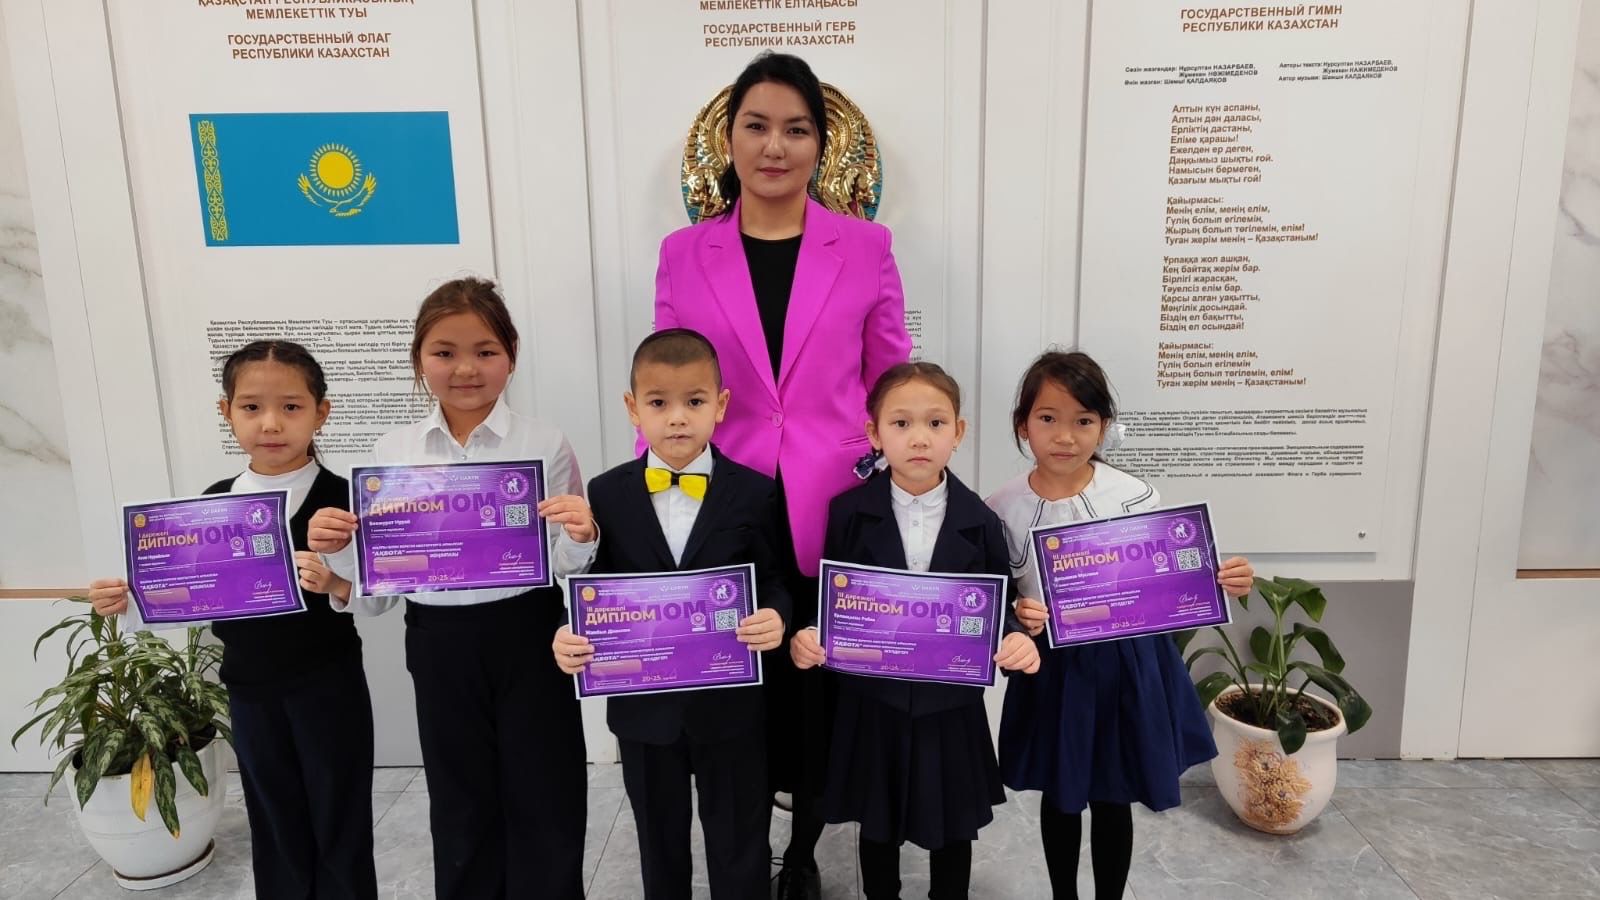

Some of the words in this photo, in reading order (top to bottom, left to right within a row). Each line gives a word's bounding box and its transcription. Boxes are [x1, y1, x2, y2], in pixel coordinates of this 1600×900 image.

[700, 0, 782, 10] МЕМЛЕКЕТТІК
[246, 8, 335, 19] МЕМЛЕКЕТТІК
[340, 8, 367, 18] ТУЫ
[1181, 5, 1305, 20] ГОСУДАРСТВЕННЫЙ
[1308, 5, 1342, 15] ГИМН
[704, 21, 822, 35] ГОСУДАРСТВЕННЫЙ
[826, 21, 856, 31] ГЕРБ
[1183, 21, 1264, 32] РЕСПУБЛИКИ
[1268, 19, 1338, 30] КАЗАХСТАН
[228, 32, 354, 46] ГОСУДАРСТВЕННЫЙ
[358, 33, 391, 43] ФЛАГ
[705, 37, 783, 47] РЕСПУБЛИКИ
[786, 35, 854, 45] КАЗАХСТАН
[232, 48, 314, 59] РЕСПУБЛИКИ
[318, 48, 390, 58] КАЗАХСТАН
[1205, 105, 1221, 114] күн
[1172, 115, 1203, 123] Алтын
[1204, 116, 1222, 124] дән
[1224, 115, 1262, 123] даласы,
[1171, 125, 1209, 135] Ерліктің
[1210, 125, 1252, 133] дастаны,
[1170, 135, 1197, 144] Еліме
[1200, 135, 1239, 144] қарашы!
[1170, 146, 1210, 154] Ежелден
[1212, 146, 1224, 155] ер
[1225, 146, 1253, 154] деген,
[1169, 156, 1218, 165] Даңқымыз
[1256, 154, 1273, 162] ғой.
[1168, 166, 1214, 174] Намысын
[1216, 165, 1261, 174] бермеген,
[1168, 176, 1207, 185] Қазағым
[1243, 174, 1262, 183] ғой!
[1167, 196, 1224, 205] Қайырмасы:
[1166, 204, 1193, 215] Менің
[1194, 205, 1217, 214] елім,
[1247, 205, 1270, 213] елім,
[1166, 216, 1190, 226] Гүлің
[1192, 216, 1222, 224] болып
[1224, 215, 1263, 223] егілемін,
[1165, 225, 1200, 235] Жырың
[1202, 226, 1232, 234] болып
[1235, 224, 1278, 233] төгілемін,
[1281, 223, 1305, 232] елім!
[1165, 235, 1189, 246] Туған
[1191, 235, 1218, 245] жерім
[1220, 235, 1246, 243] менің
[1164, 256, 1199, 265] Ұрпаққа
[1163, 264, 1179, 274] Кең
[1181, 265, 1212, 273] байтақ
[1214, 264, 1240, 273] жерім
[1242, 264, 1260, 273] бар.
[1162, 274, 1191, 284] Бірлігі
[1193, 276, 1237, 284] жарасқан,
[1162, 284, 1200, 294] Тәуелсіз
[1202, 283, 1222, 292] елім
[1224, 283, 1243, 293] бар.
[1161, 292, 1190, 303] Қарсы
[1219, 294, 1260, 303] уақытты,
[1161, 303, 1198, 312] Мәңгілік
[1199, 302, 1246, 312] досындай.
[1160, 313, 1188, 322] Біздің
[1202, 312, 1244, 321] бақытты,
[1160, 322, 1187, 332] Біздің
[1202, 322, 1244, 331] осындай!
[1158, 342, 1214, 350] Қайырмасы:
[1158, 349, 1184, 359] Менің
[1158, 360, 1181, 370] Гүлің
[1183, 360, 1213, 368] болып
[1214, 359, 1251, 368] егілемін
[1157, 368, 1191, 379] Жырың
[1193, 369, 1222, 378] болып
[1225, 369, 1267, 377] төгілемін,
[1270, 368, 1294, 376] елім!
[1157, 378, 1181, 389] Туған
[1182, 378, 1208, 388] жерім
[1210, 379, 1236, 387] менің
[369, 500, 444, 516] ДИПЛОМ
[138, 534, 198, 551] ДИПЛОМ
[1053, 551, 1120, 573] ДИПЛОМ
[835, 598, 903, 614] ДИПЛОМ
[585, 609, 656, 625] ДИПЛОМ
